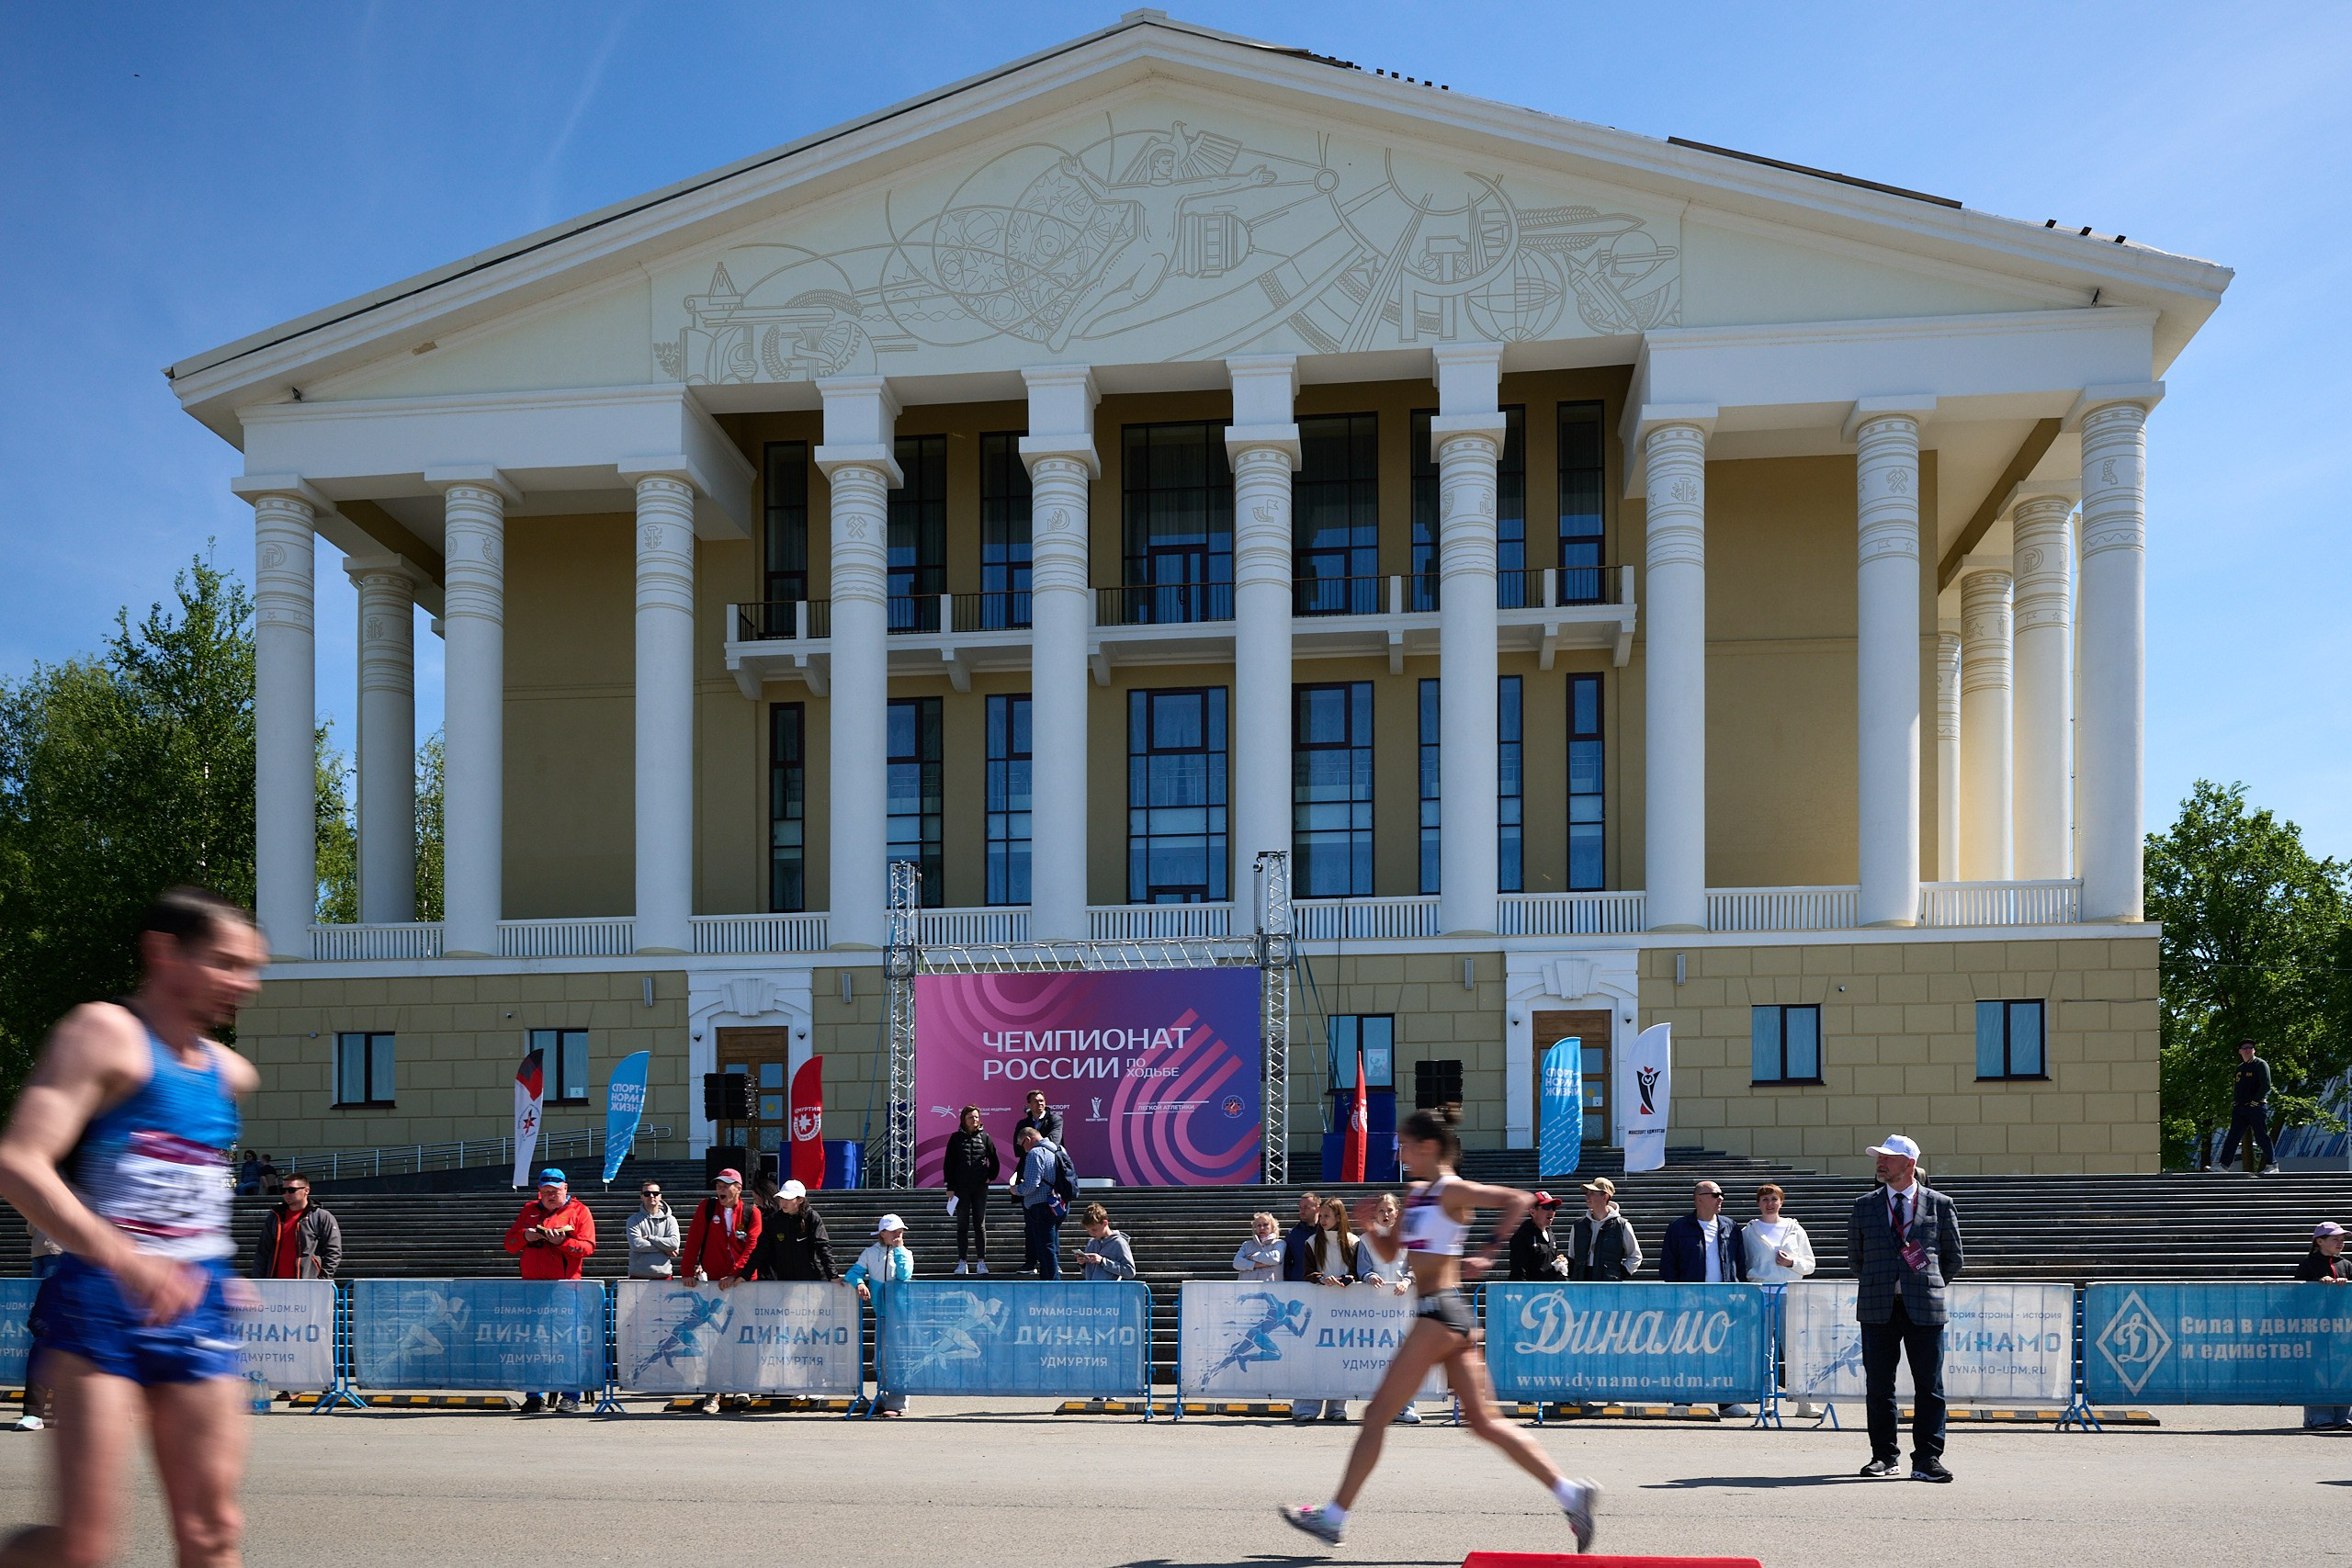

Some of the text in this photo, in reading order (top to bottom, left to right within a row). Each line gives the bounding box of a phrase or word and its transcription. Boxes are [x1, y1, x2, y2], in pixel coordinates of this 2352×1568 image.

[982, 1027, 1192, 1053] ЧЕМПИОНАТ
[1126, 1058, 1146, 1067] ПО
[983, 1056, 1119, 1081] РОССИИ
[1126, 1067, 1180, 1078] ХОДЬБЕ
[610, 1092, 641, 1102] НОРМ
[493, 1306, 574, 1315] DINAMO-UDM.RU
[754, 1308, 831, 1316] DINAMO-UDM.RU
[1029, 1307, 1120, 1316] DYNAMO-UDM.RU
[1330, 1309, 1419, 1318] DYNAMO-UDM.R
[2022, 1312, 2062, 1320] история
[2181, 1316, 2230, 1335] Сила
[2241, 1317, 2253, 1334] в
[230, 1323, 320, 1342] ИНАМО
[475, 1324, 593, 1343] ДИНАМО
[736, 1325, 848, 1345] ДИНАМО
[1013, 1325, 1136, 1345] ДИНАМО
[1315, 1327, 1407, 1348] ДИНА
[2181, 1341, 2312, 1361] и единстве!
[500, 1354, 565, 1365] УДМУРТИЯ
[761, 1357, 823, 1367] УДМУРТИЯ
[1040, 1357, 1108, 1368] УДМУРТИЯ
[1342, 1359, 1395, 1371] УДМУРТ
[1949, 1365, 2047, 1374] DYNAMO-UDM.RU
[1517, 1371, 1735, 1392] www.dynamo-udm.ru
